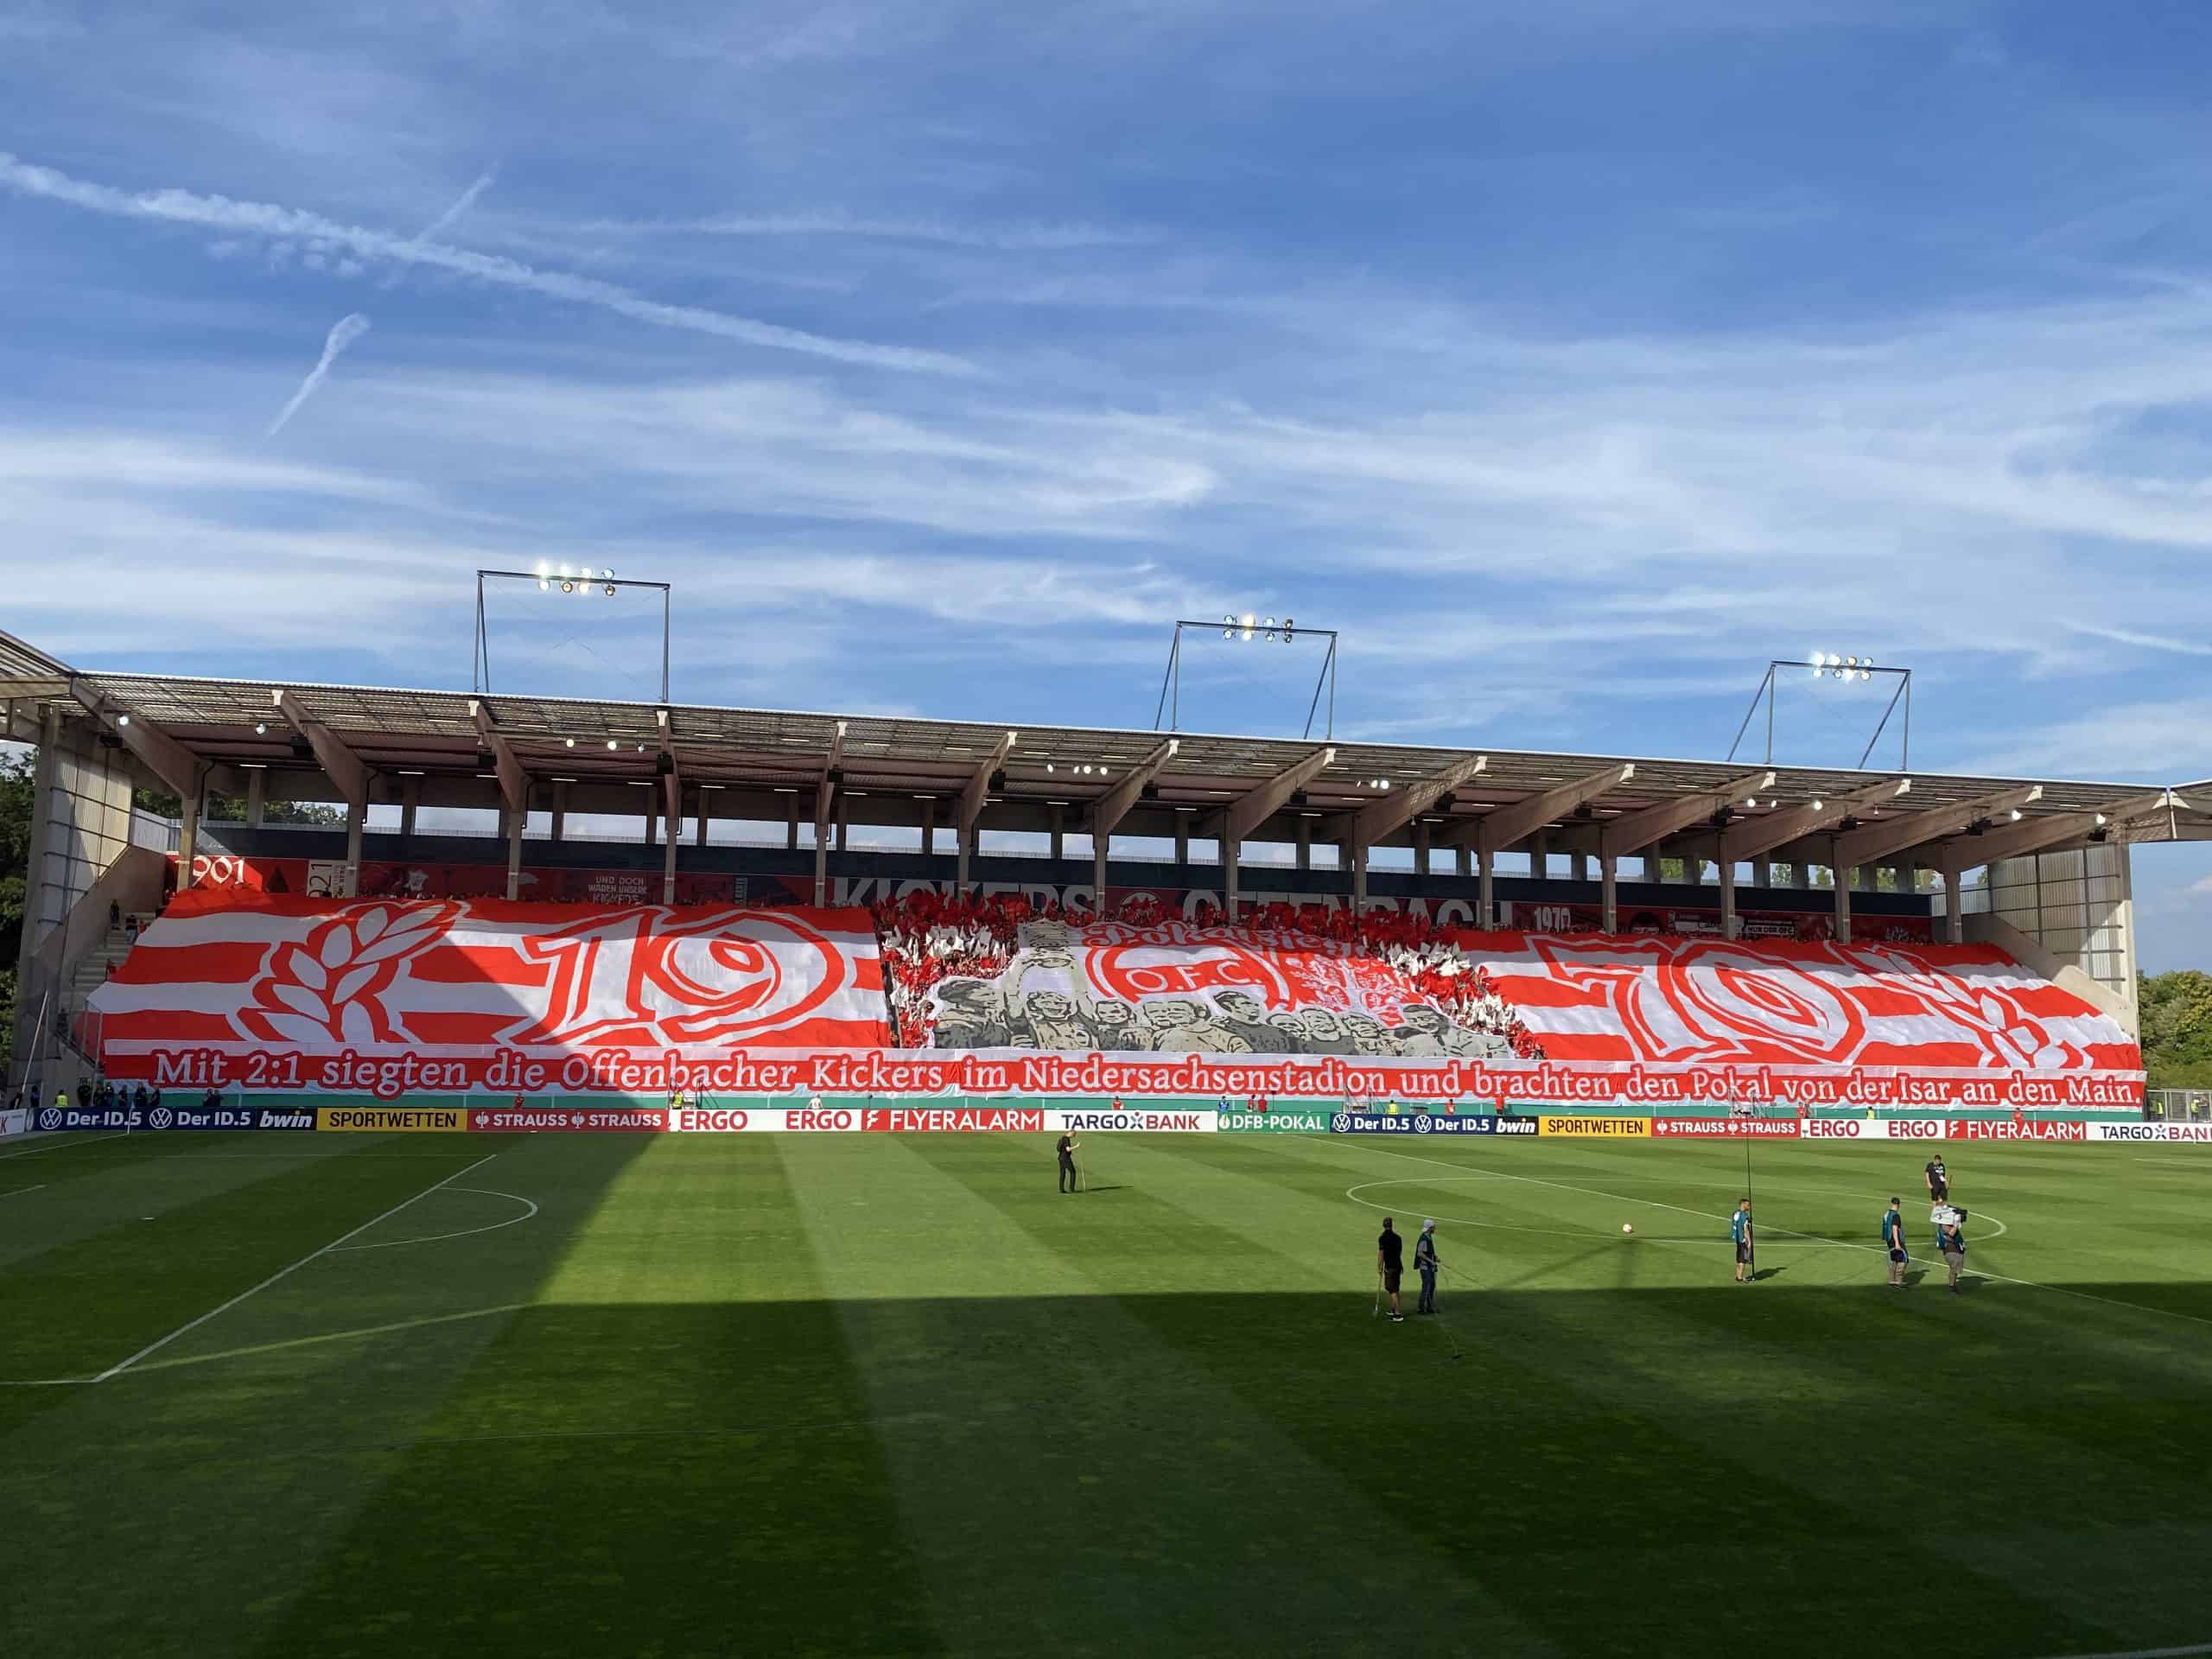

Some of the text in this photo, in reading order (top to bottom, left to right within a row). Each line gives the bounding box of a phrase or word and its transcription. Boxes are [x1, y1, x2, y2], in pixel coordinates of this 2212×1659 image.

[154, 1052, 2142, 1105] Mit 2:1 siegten die Offenbacher Kickers im Niedersachsenstadion und brachten den Pokal von der Isar an den Main.
[67, 1112, 102, 1127] Der
[104, 1111, 142, 1127] ID.5
[177, 1111, 210, 1127] Der
[215, 1111, 251, 1127] ID.5
[259, 1109, 312, 1128] bwin
[329, 1111, 457, 1128] SPORTWETTEN
[493, 1113, 661, 1127] STRAUSS STRAUSS
[680, 1109, 852, 1131] ERGO ERGO
[889, 1110, 1042, 1130] FLYERALARM
[1232, 1114, 1324, 1130] DFB-POKAL
[1354, 1117, 1379, 1130] Der
[1382, 1117, 1409, 1130] ID.5
[1435, 1118, 1459, 1131] Der
[1462, 1118, 1490, 1132] ID.5
[1496, 1120, 1536, 1134] bwin
[1548, 1120, 1643, 1135] SPORTWETTEN
[1670, 1121, 1796, 1135] STRAUSS STRAUSS
[1809, 1120, 1938, 1138] ERGO ERGO
[1967, 1121, 2086, 1141] FLYERALARM
